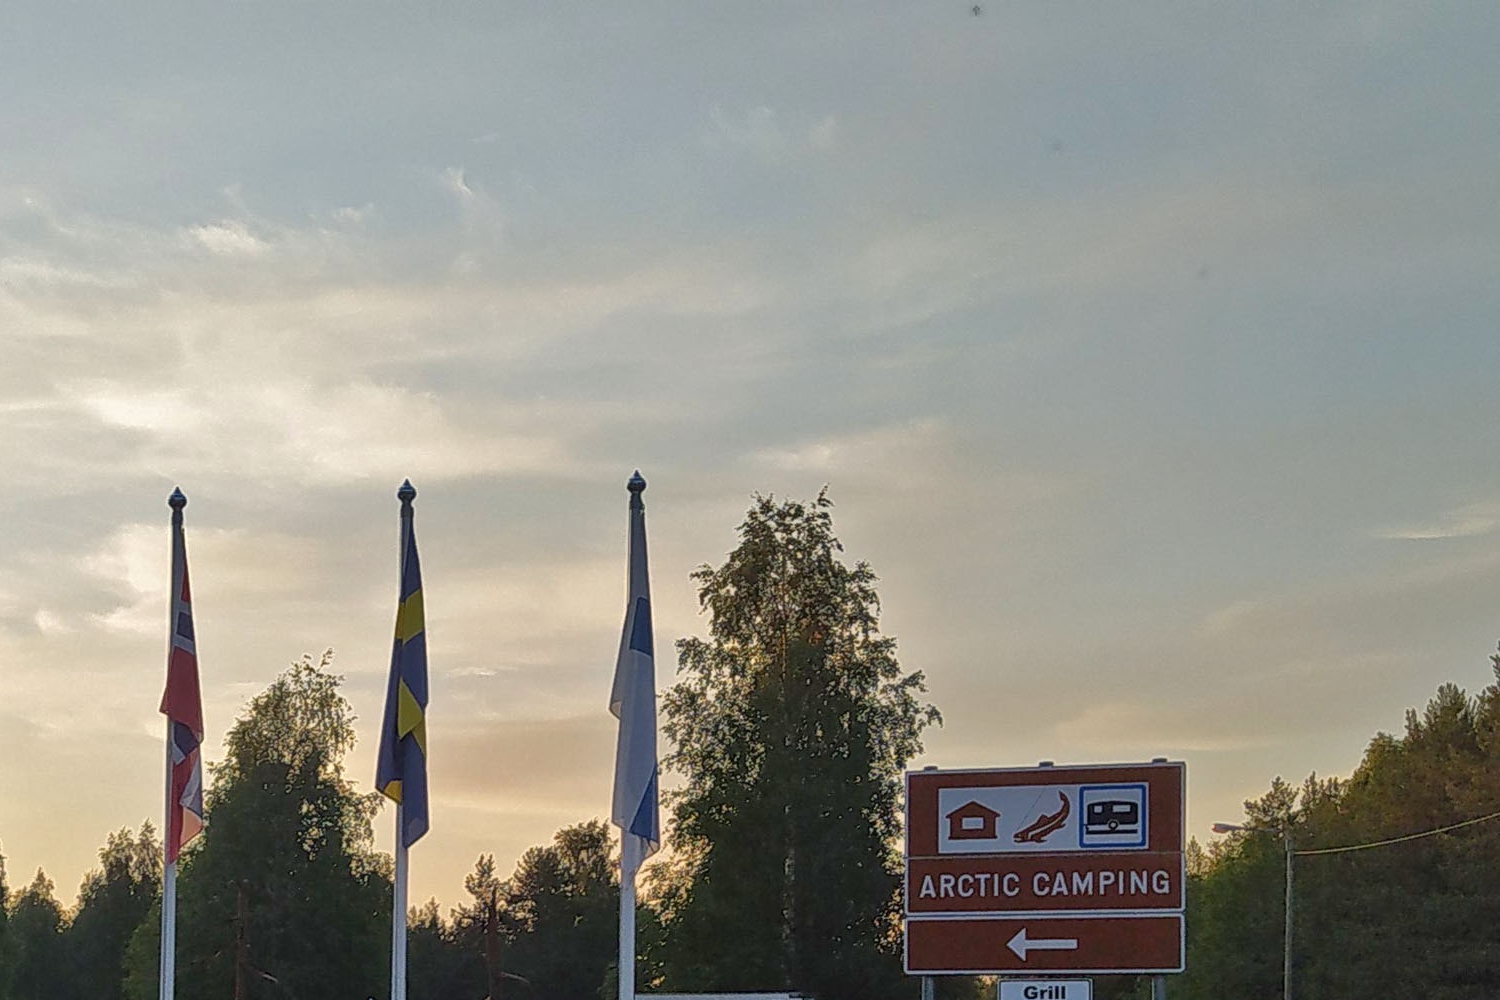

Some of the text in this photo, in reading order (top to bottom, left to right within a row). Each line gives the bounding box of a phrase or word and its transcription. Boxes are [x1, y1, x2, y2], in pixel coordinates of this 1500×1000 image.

[919, 870, 1170, 898] ARCTIC CAMPING
[1024, 985, 1066, 999] Grill
